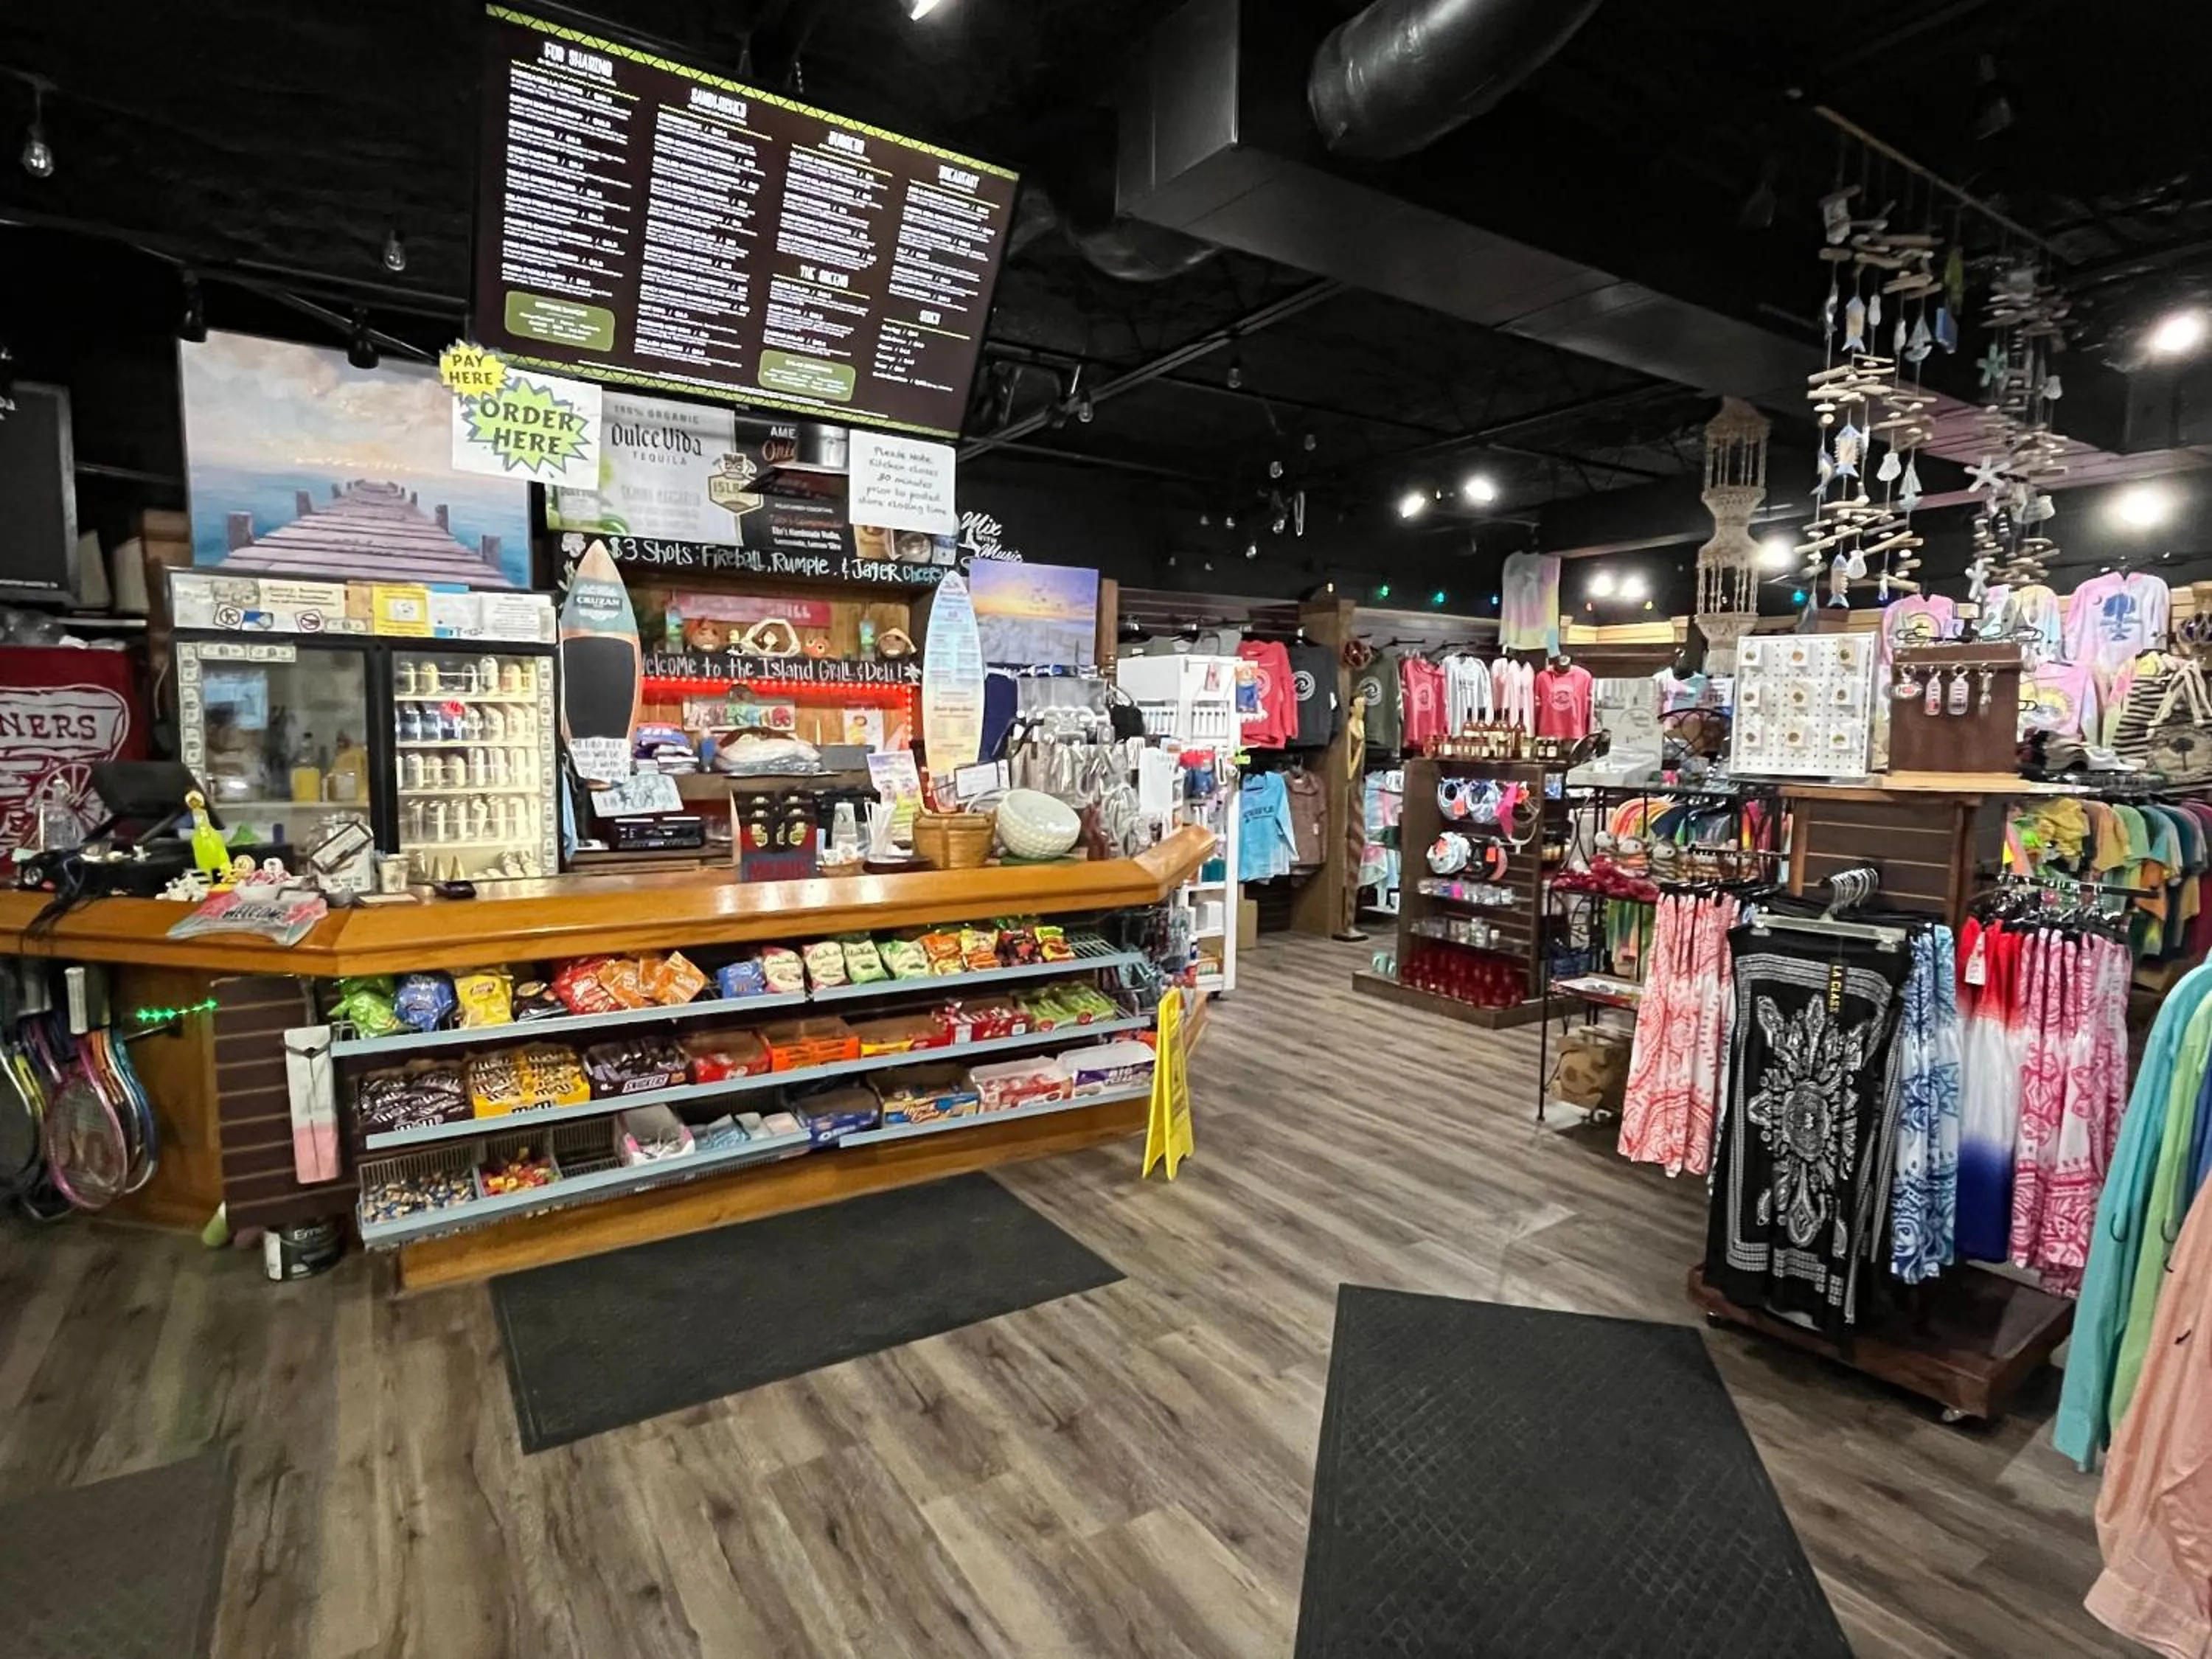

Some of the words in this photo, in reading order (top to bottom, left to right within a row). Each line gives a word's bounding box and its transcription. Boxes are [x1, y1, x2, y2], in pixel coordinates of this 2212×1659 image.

[543, 41, 565, 63] FOR
[451, 352, 487, 367] PAY
[448, 371, 495, 387] HERE
[479, 399, 577, 432] ORDER
[647, 408, 700, 425] ORGANIC
[493, 426, 563, 456] HERE
[632, 451, 688, 466] TEQUILA
[960, 511, 1002, 537] Mix
[608, 536, 639, 560] $3
[641, 539, 700, 566] Shots:
[702, 656, 722, 678] to
[728, 656, 755, 678] the
[759, 656, 814, 681] Island
